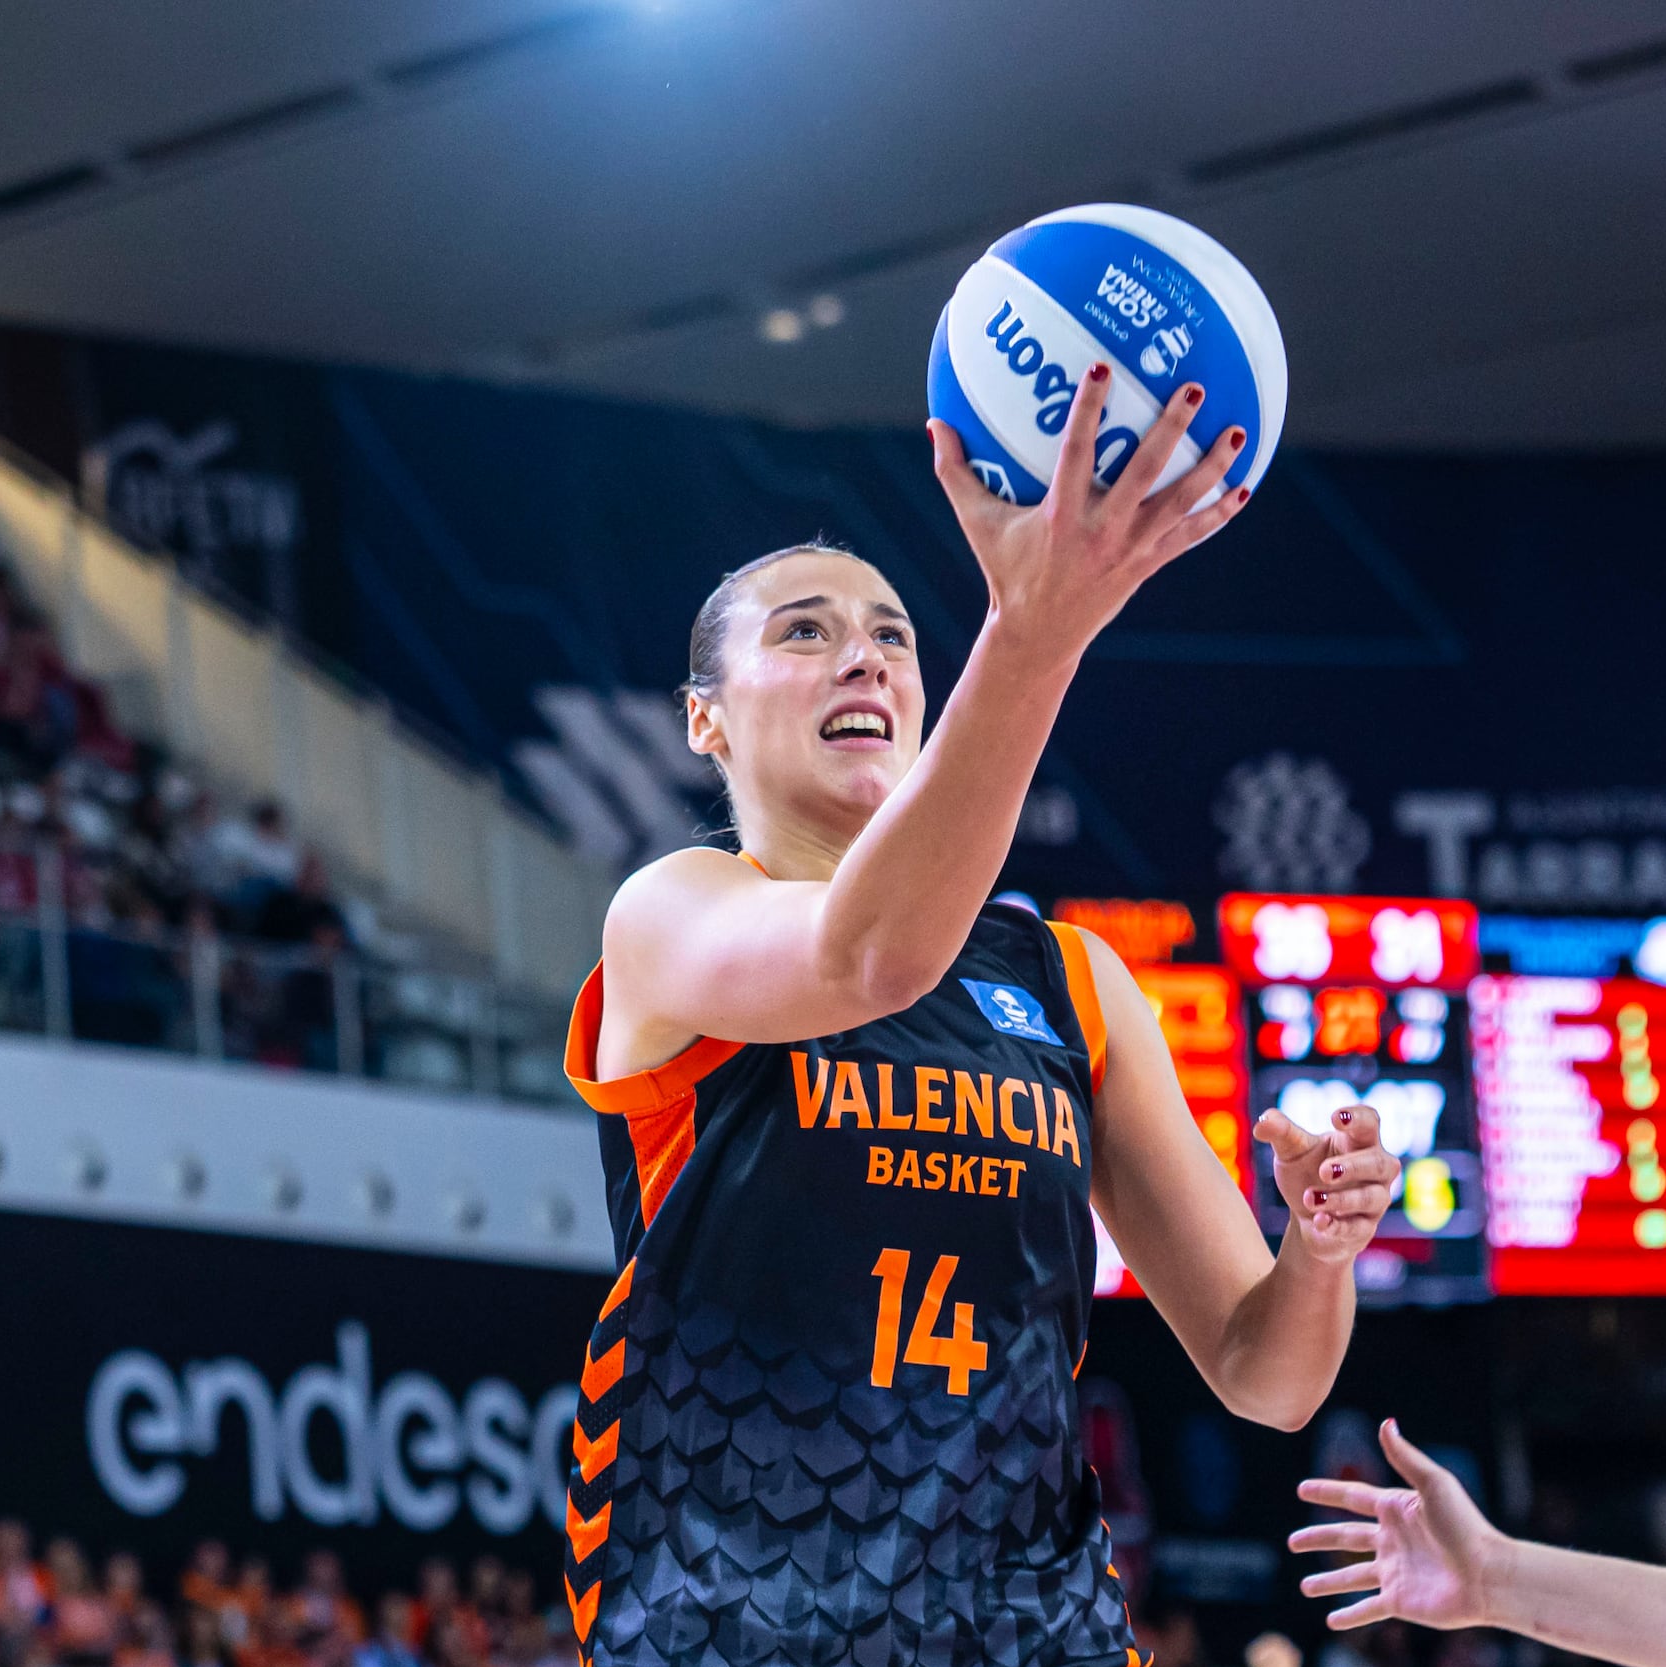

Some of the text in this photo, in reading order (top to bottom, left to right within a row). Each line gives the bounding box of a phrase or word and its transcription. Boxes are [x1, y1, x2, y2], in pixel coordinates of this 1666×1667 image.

[1097, 278, 1151, 331] COPA
[1107, 263, 1158, 311] REINA
[790, 1052, 1081, 1167] VALENCIA
[866, 1146, 1026, 1198] BASKET
[871, 1247, 988, 1396] 14
